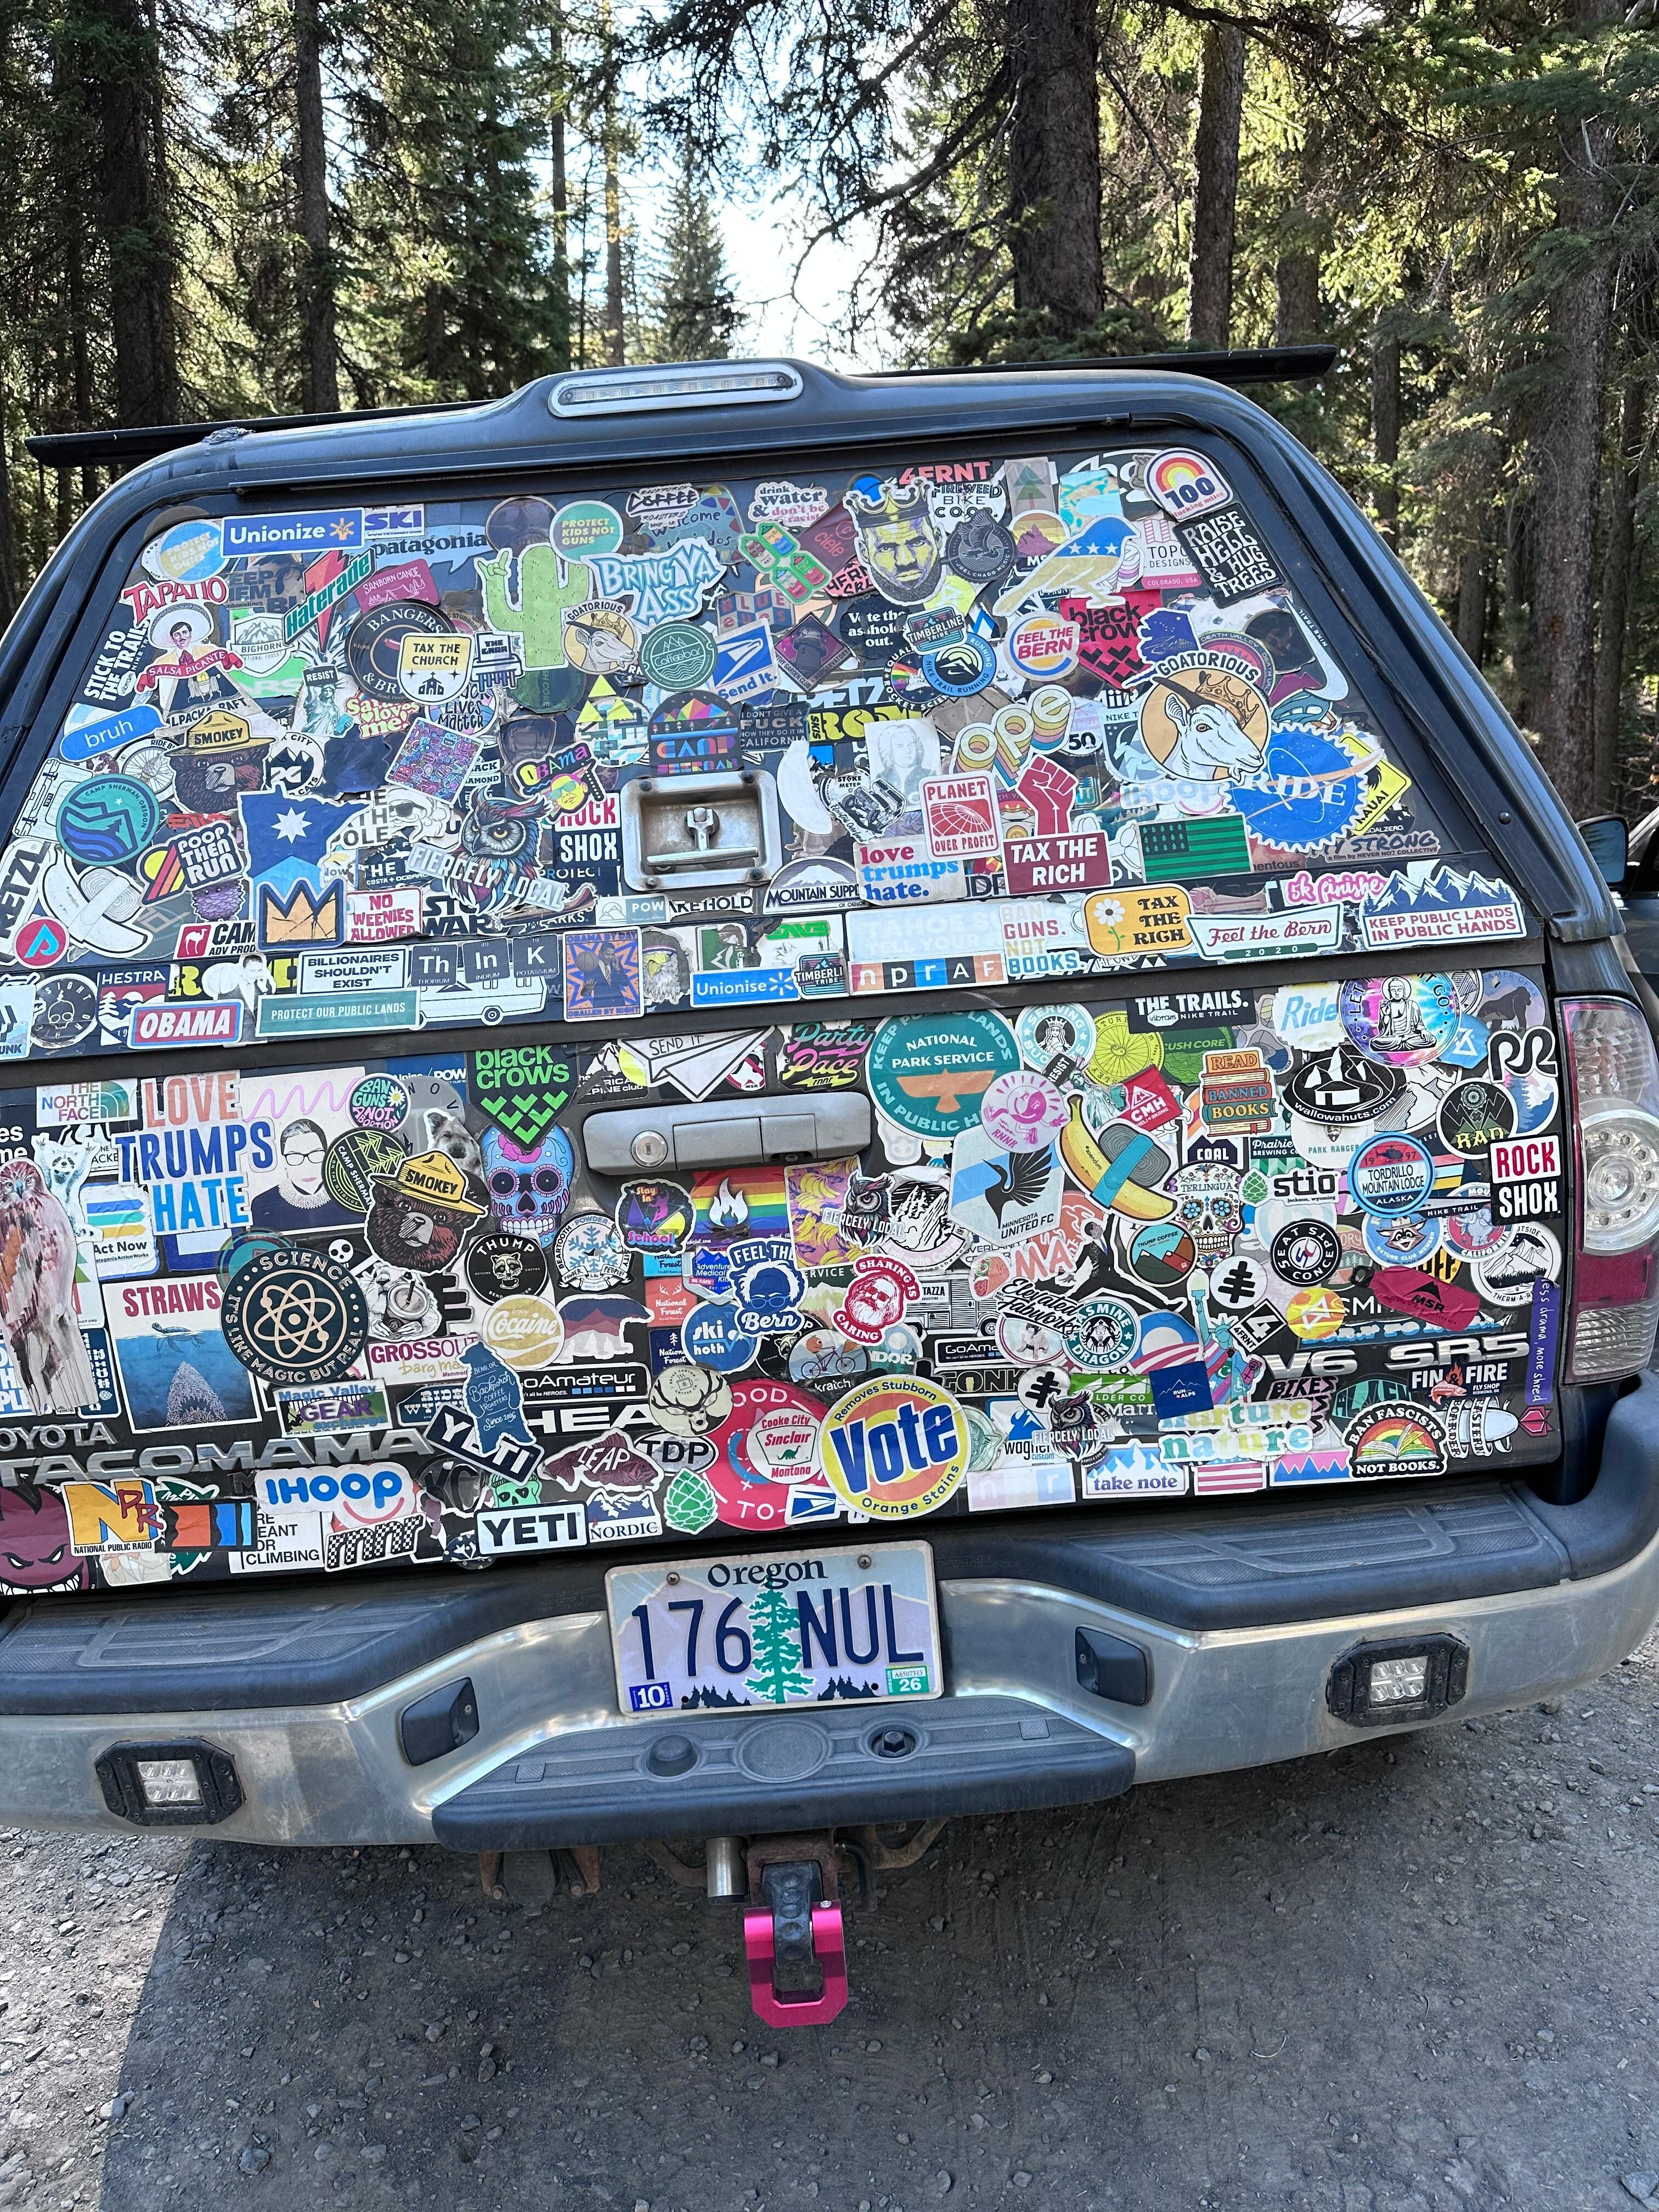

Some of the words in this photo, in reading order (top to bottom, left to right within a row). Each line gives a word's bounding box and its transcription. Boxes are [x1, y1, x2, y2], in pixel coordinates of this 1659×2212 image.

[1163, 478, 1216, 509] 100
[1173, 501, 1203, 517] fucking
[1204, 492, 1224, 503] miles
[365, 511, 422, 530] SKI
[562, 518, 609, 528] PROTECT
[1183, 512, 1245, 546] RAISE
[230, 523, 325, 544] Unionize
[562, 528, 589, 537] KIDS
[592, 527, 614, 535] NOT
[562, 537, 594, 545] GUNS
[375, 534, 487, 558] patagonia
[1192, 528, 1255, 569] HELL
[1208, 566, 1227, 582] &
[1230, 548, 1267, 575] HUG
[1214, 563, 1276, 597] TREES
[287, 555, 370, 637] Haterade
[1017, 632, 1046, 645] FEEL
[1049, 627, 1073, 640] THE
[241, 642, 283, 653] BIGHORN
[414, 644, 434, 653] TAX
[439, 644, 460, 653] THE
[1018, 640, 1074, 659] BERN
[149, 664, 182, 678] SALSA
[185, 652, 225, 674] PICANTE
[413, 656, 458, 665] CHURCH
[1157, 653, 1261, 682] GOATORIOUS
[307, 670, 334, 682] RESIST
[85, 719, 133, 748] bruh
[194, 727, 242, 746] SMOKEY
[927, 781, 986, 801] PLANET
[1239, 768, 1347, 806] RIDE
[178, 830, 224, 853] POOP
[182, 839, 229, 864] THEN
[935, 839, 960, 853] OVER
[963, 834, 995, 849] PROFIT
[1011, 842, 1053, 863] TAX
[1057, 837, 1098, 859] THE
[1351, 834, 1437, 853] STRONG
[861, 845, 913, 863] love
[191, 853, 236, 885] RUN
[410, 847, 500, 888] FIERCELY
[504, 874, 563, 910] LOCAL
[861, 860, 959, 883] trumps
[1032, 864, 1084, 886] RICH
[865, 883, 929, 902] hate.
[1137, 898, 1179, 912] TAX
[1139, 913, 1181, 927] THE
[1370, 917, 1405, 929] KEEP
[1410, 913, 1460, 924] PUBLIC
[1465, 908, 1513, 921] LANDS
[1133, 929, 1186, 945] RICH
[1207, 928, 1245, 946] Feel
[1251, 926, 1280, 941] the
[1284, 921, 1331, 939] Bern
[1373, 931, 1390, 941] IN
[1395, 926, 1453, 939] PUBLIC
[1459, 920, 1516, 933] HANDS
[308, 954, 399, 966] BILLIONAIRES
[315, 966, 391, 977] SHOULDN'T
[334, 978, 371, 988] EXIST
[697, 982, 767, 995] Unionise
[271, 1008, 314, 1020] PROTECT
[316, 1006, 335, 1018] OUR
[338, 1004, 372, 1017] PUBLIC
[374, 1002, 406, 1014] LANDS
[140, 1009, 230, 1038] OBAMA
[650, 1039, 683, 1056] SEND
[691, 1036, 704, 1045] IT
[906, 1036, 978, 1051] NATIONAL
[893, 1056, 931, 1068] PARK
[934, 1052, 995, 1064] SERVICE
[1211, 1054, 1257, 1070] READ
[145, 1074, 237, 1127] LOVE
[1208, 1086, 1268, 1101] BANNED
[1212, 1103, 1268, 1119] BOOKS
[1294, 1096, 1396, 1122] wallowahuts.com
[115, 1122, 273, 1183] TRUMPS
[1496, 1142, 1555, 1177] ROCK
[405, 1169, 459, 1195] SMOKEY
[1368, 1166, 1413, 1178] TORDRILLO
[1181, 1182, 1233, 1192] TERLINGUA
[1274, 1174, 1336, 1197] stio
[1363, 1178, 1400, 1194] MOUNTAIN
[1401, 1176, 1424, 1189] LODGE
[153, 1177, 249, 1231] HATE
[1376, 1195, 1413, 1204] ALASKA
[1001, 1218, 1038, 1240] UNITED
[1041, 1213, 1054, 1225] FC
[1002, 1212, 1038, 1229] MINNESOTA
[259, 1250, 353, 1291] SCIENCE
[860, 1258, 911, 1283] SHARING
[908, 1285, 917, 1298] IS
[123, 1282, 221, 1317] STRAWS
[1541, 1280, 1550, 1305] less
[488, 1314, 557, 1340] Cocaine
[836, 1314, 879, 1340] CARING
[1385, 1333, 1530, 1369] SR5
[1536, 1346, 1546, 1372] more
[1263, 1348, 1358, 1377] V6
[1412, 1372, 1443, 1389] FIN
[1449, 1374, 1459, 1384] &
[1465, 1363, 1507, 1384] FIRE
[278, 1391, 325, 1401] Magic
[329, 1385, 376, 1398] Valley
[1532, 1373, 1548, 1402] shred
[300, 1401, 371, 1423] GEAR
[835, 1385, 879, 1421] Removes
[881, 1381, 938, 1401] Stubborn
[762, 1418, 789, 1429] Cooke
[792, 1415, 810, 1426] City
[1350, 1417, 1374, 1444] BAN
[1376, 1407, 1442, 1440] FASCISTS
[765, 1432, 811, 1446] Sinclair
[830, 1404, 958, 1494] Vote
[1164, 1429, 1312, 1460] nature
[771, 1465, 811, 1478] Montana
[1357, 1464, 1386, 1475] NOT
[1388, 1460, 1440, 1472] BOOKS.
[266, 1471, 403, 1509] IHOOP
[862, 1498, 918, 1515] Orange
[923, 1465, 959, 1505] Stains
[1094, 1476, 1133, 1491] take
[1139, 1476, 1177, 1490] note
[483, 1511, 577, 1547] YETI
[591, 1522, 658, 1540] NORDIC
[75, 1544, 106, 1553] NATIONAL
[708, 1559, 828, 1590] Oregon
[631, 1596, 752, 1680] 176
[797, 1584, 923, 1669] NUL
[899, 1678, 921, 1692] 26
[637, 1686, 665, 1708] 10
